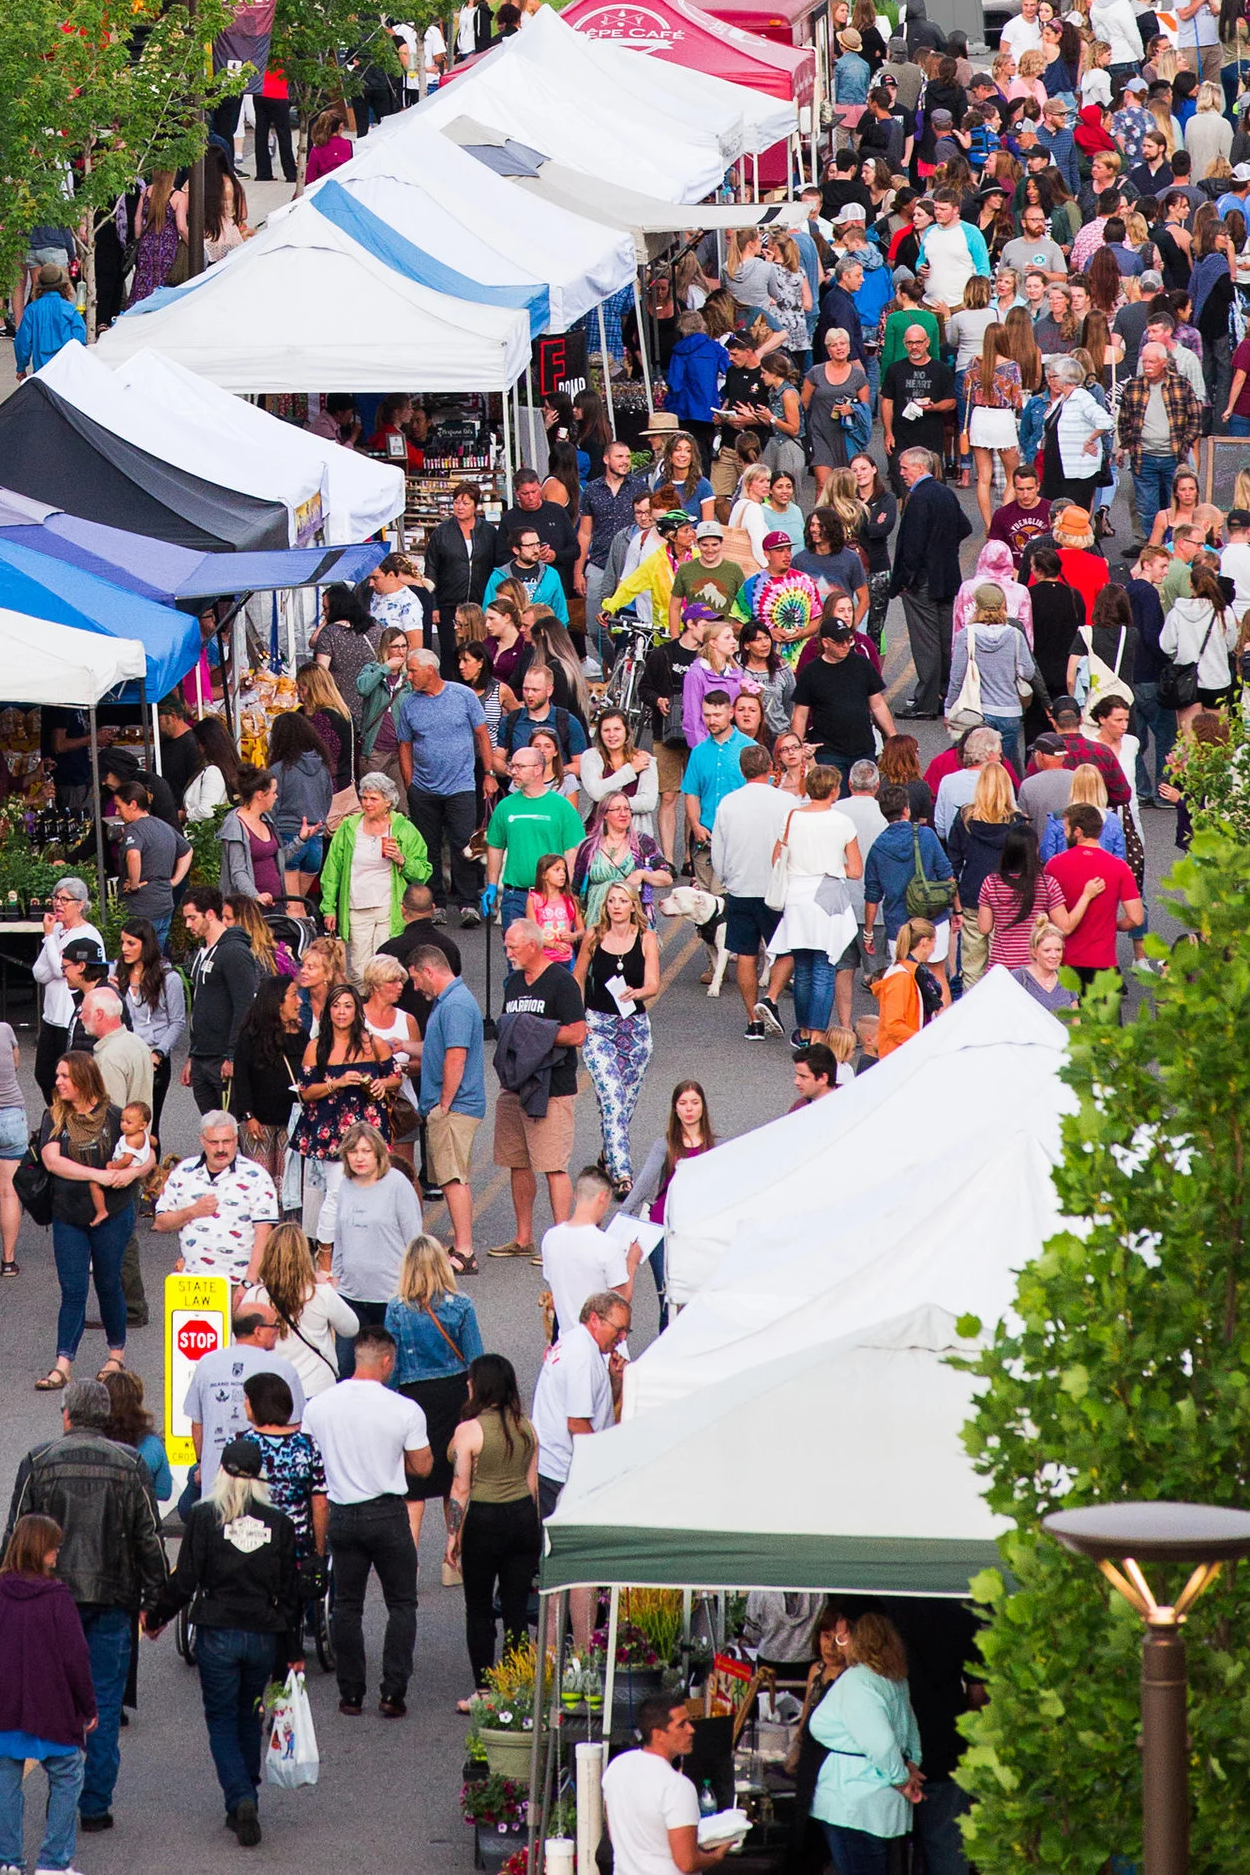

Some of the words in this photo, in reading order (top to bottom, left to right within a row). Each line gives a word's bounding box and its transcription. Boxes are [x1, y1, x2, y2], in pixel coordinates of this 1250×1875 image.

[629, 28, 685, 40] CAFÉ
[913, 371, 926, 379] NO
[905, 379, 932, 389] HEART
[506, 999, 546, 1014] WARRIOR
[178, 1281, 217, 1293] STATE
[184, 1296, 211, 1307] LAW
[179, 1331, 217, 1349] STOP
